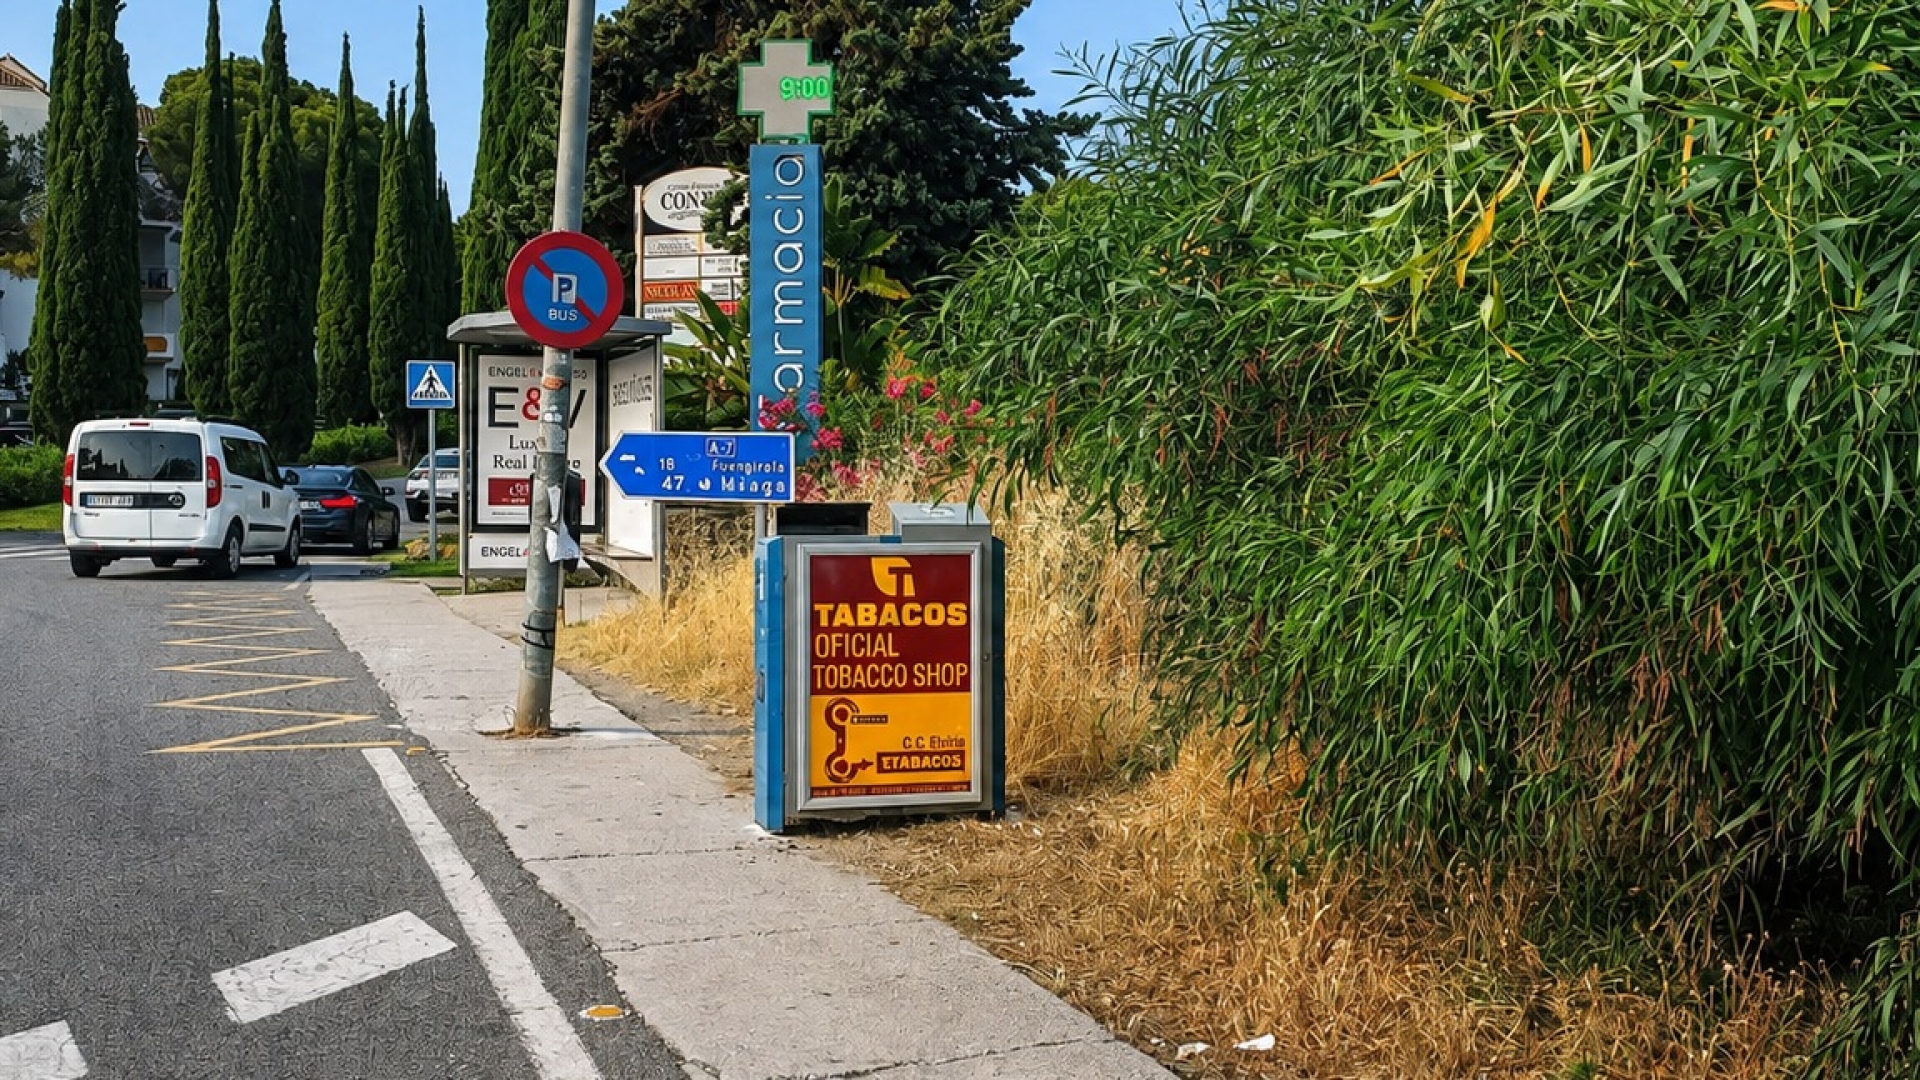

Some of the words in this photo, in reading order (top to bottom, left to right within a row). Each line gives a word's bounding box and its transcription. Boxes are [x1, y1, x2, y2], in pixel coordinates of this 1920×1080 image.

[780, 77, 829, 99] 9:00
[548, 308, 578, 322] BUS
[709, 441, 733, 454] A-7
[493, 454, 527, 469] Real
[659, 457, 675, 471] 18
[661, 474, 685, 491] 47
[813, 602, 967, 628] TABACOS
[814, 632, 900, 658] OFICIAL
[813, 664, 908, 689] TOBACCO
[913, 662, 968, 687] SHOP
